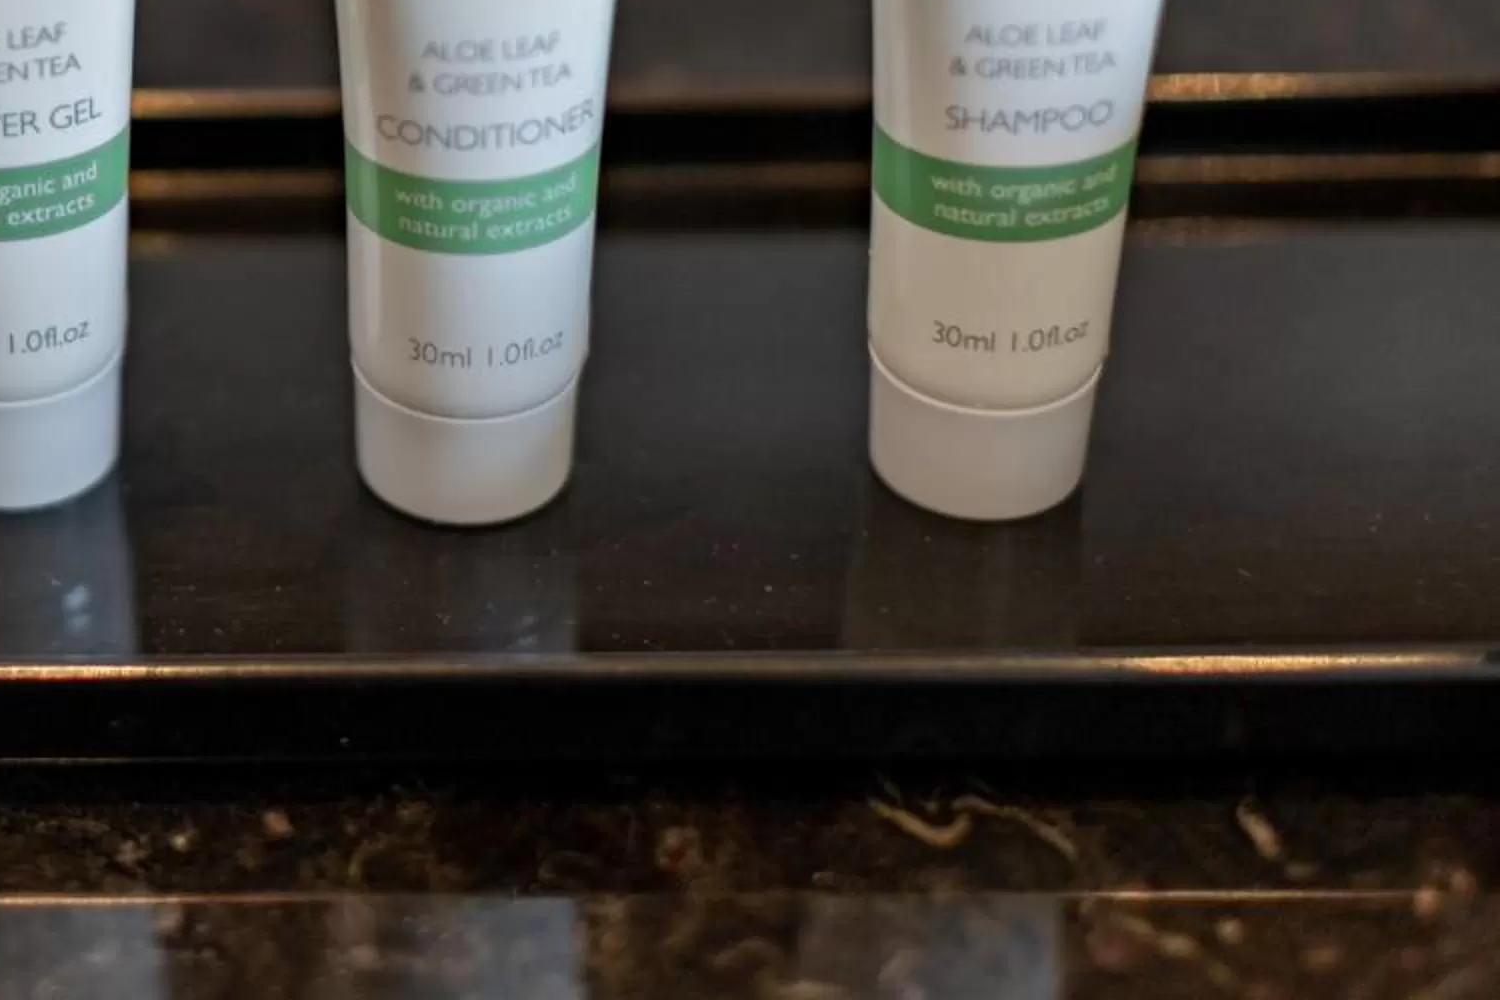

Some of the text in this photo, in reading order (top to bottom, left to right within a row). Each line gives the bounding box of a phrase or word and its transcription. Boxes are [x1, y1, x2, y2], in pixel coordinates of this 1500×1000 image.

[7, 22, 68, 50] LEAF
[421, 32, 561, 63] ALOE LEAF
[964, 19, 1108, 48] ALOE LEAF
[33, 54, 81, 80] TEA
[408, 63, 573, 97] & GREEN TEA
[948, 51, 1116, 80] & GREEN TEA
[49, 96, 103, 131] GEL
[375, 99, 595, 152] CONDITIONER
[945, 100, 1115, 136] SHAMPOO
[61, 160, 98, 193] and
[930, 163, 1118, 205] with organic and
[6, 192, 94, 227] extracts
[394, 173, 578, 219] with organic and
[933, 195, 1110, 228] natural extracts
[398, 206, 573, 241] natural extracts
[931, 320, 996, 352] 30ml
[407, 338, 473, 369] 30ml
